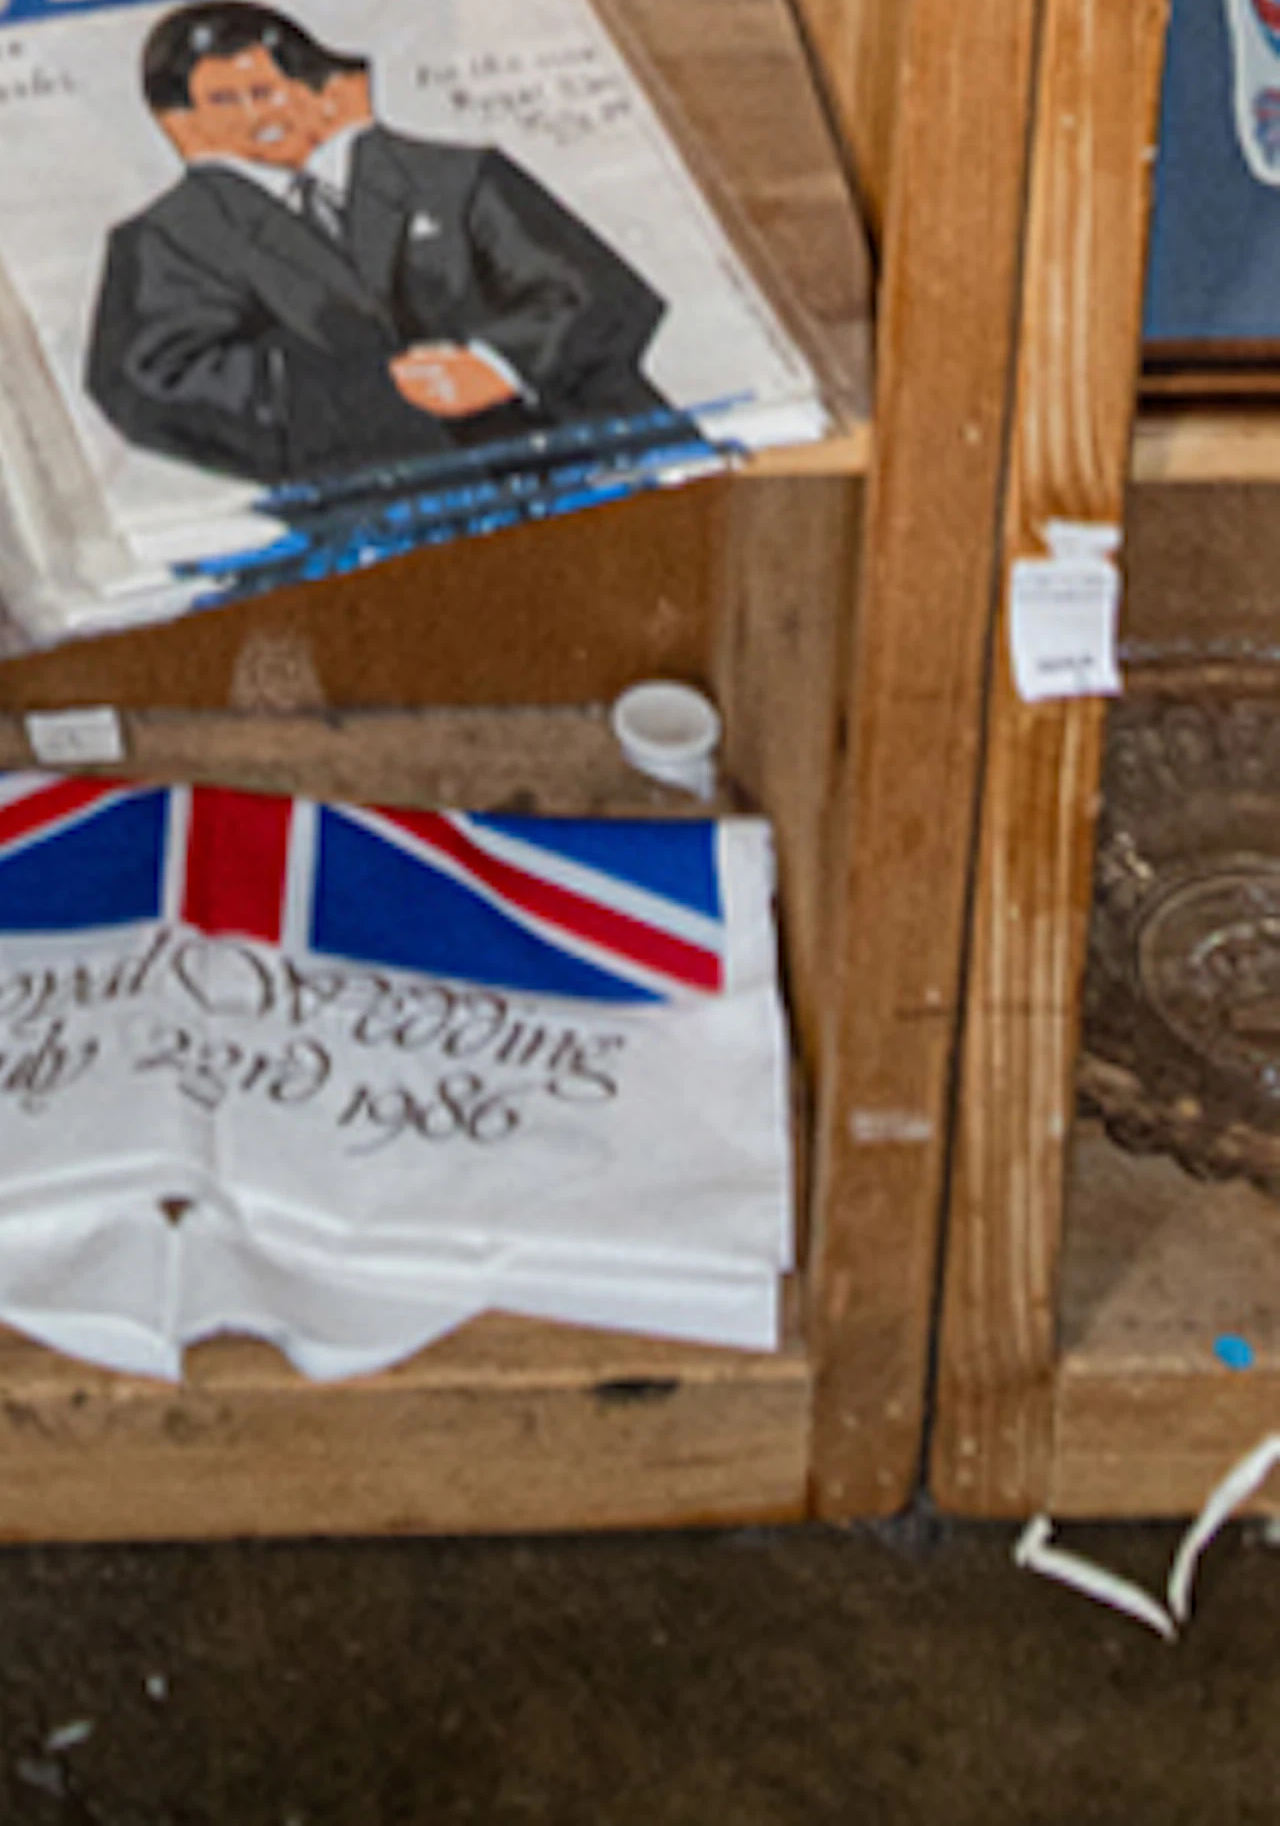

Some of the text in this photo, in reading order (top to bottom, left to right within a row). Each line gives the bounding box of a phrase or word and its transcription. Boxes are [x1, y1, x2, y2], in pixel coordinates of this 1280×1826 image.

[130, 1025, 333, 1109] 23rd
[336, 1081, 524, 1158] 1986
[162, 936, 627, 1102] Wedding
